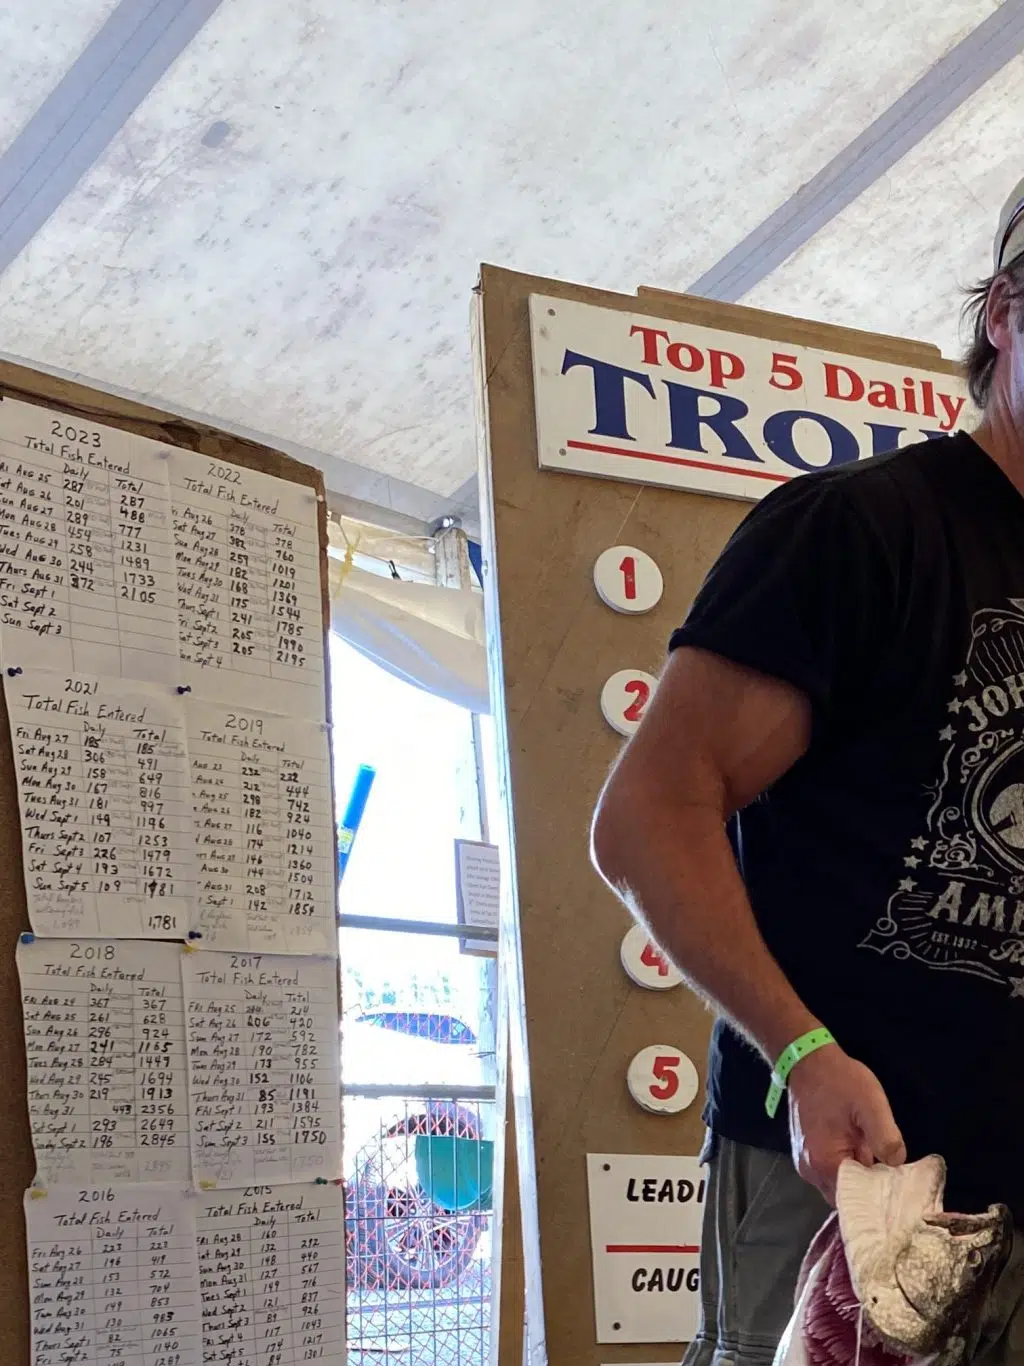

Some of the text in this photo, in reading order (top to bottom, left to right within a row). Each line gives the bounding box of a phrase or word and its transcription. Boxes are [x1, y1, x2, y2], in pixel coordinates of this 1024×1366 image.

[629, 325, 966, 430] Top 5 Daily
[51, 421, 101, 448] 2023
[24, 436, 129, 474] Total Fish Entered
[63, 463, 143, 494] Daily Total
[208, 463, 241, 484] 2022
[63, 479, 145, 508] 287 287
[184, 478, 279, 514] Total Fish Entered
[66, 496, 145, 523] 201 488
[272, 524, 296, 537] Total
[276, 538, 292, 549] 378
[70, 559, 155, 586] 244 1733
[619, 557, 637, 600] 1
[1, 613, 21, 627] Sun
[56, 625, 62, 634] 3
[232, 612, 304, 636] 241 1785
[233, 642, 306, 666] 205 2195
[65, 679, 98, 695] 2021
[22, 695, 146, 722] Total Fish Entered
[624, 680, 650, 721] 2
[84, 721, 166, 742] Daily Total
[225, 714, 263, 735] 2019
[56, 734, 68, 742] 27
[84, 736, 100, 748] 185
[137, 743, 153, 754] 185
[200, 730, 285, 752] Total Fish Entered
[281, 760, 304, 770] Total
[286, 786, 309, 797] 444
[246, 824, 311, 840] 116 1040
[95, 862, 173, 877] 193 1672
[246, 885, 314, 900] 208 1712
[148, 916, 176, 930] 1,781
[70, 944, 115, 960] 2018
[640, 940, 669, 976] 4
[231, 956, 262, 969] 2017
[44, 964, 145, 981] Total Fish Entered
[196, 969, 299, 986] Total Fish Entered
[138, 984, 165, 997] Total
[285, 991, 309, 1003] Total
[90, 998, 166, 1010] 367 367
[251, 1031, 315, 1042] 172 592
[649, 1056, 680, 1099] 5
[92, 1119, 174, 1132] 293 2649
[256, 1116, 321, 1129] 211 1595
[94, 1134, 175, 1148] 196 2845
[258, 1130, 326, 1145] 155 1750
[78, 1188, 115, 1203] 2016
[243, 1186, 272, 1197] 2015
[205, 1196, 303, 1217] Total Fish Entered
[53, 1208, 161, 1226] Total Fish Entered
[295, 1209, 320, 1222] Total
[147, 1225, 174, 1237] Total
[261, 1239, 319, 1253] 132 292
[103, 1270, 170, 1282] 153 572
[153, 1342, 178, 1353] 1140
